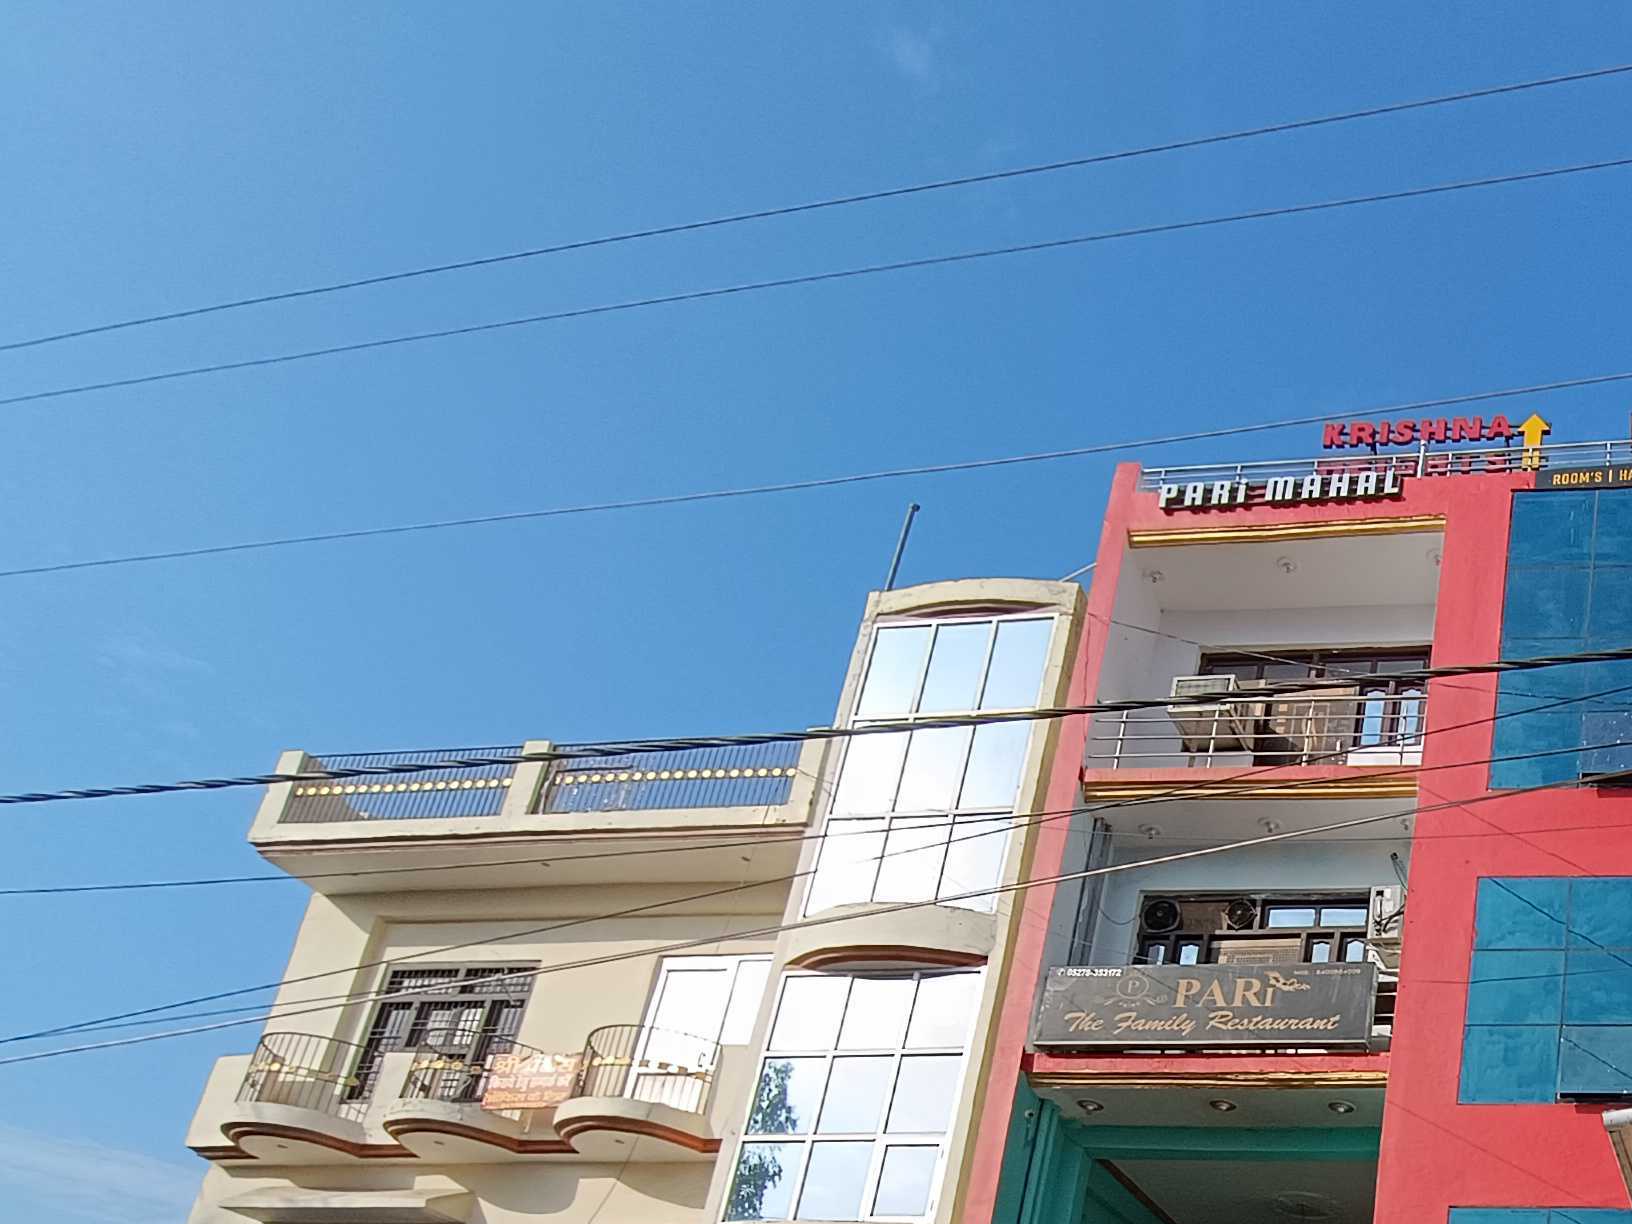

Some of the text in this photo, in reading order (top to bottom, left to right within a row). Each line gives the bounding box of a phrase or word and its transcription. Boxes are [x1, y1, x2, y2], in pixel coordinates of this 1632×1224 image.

[1323, 416, 1513, 449] KRISHNA
[1265, 467, 1401, 502] MAHAL
[1552, 470, 1602, 486] ROOM'S
[1063, 1010, 1342, 1037] The Family Restaurant
